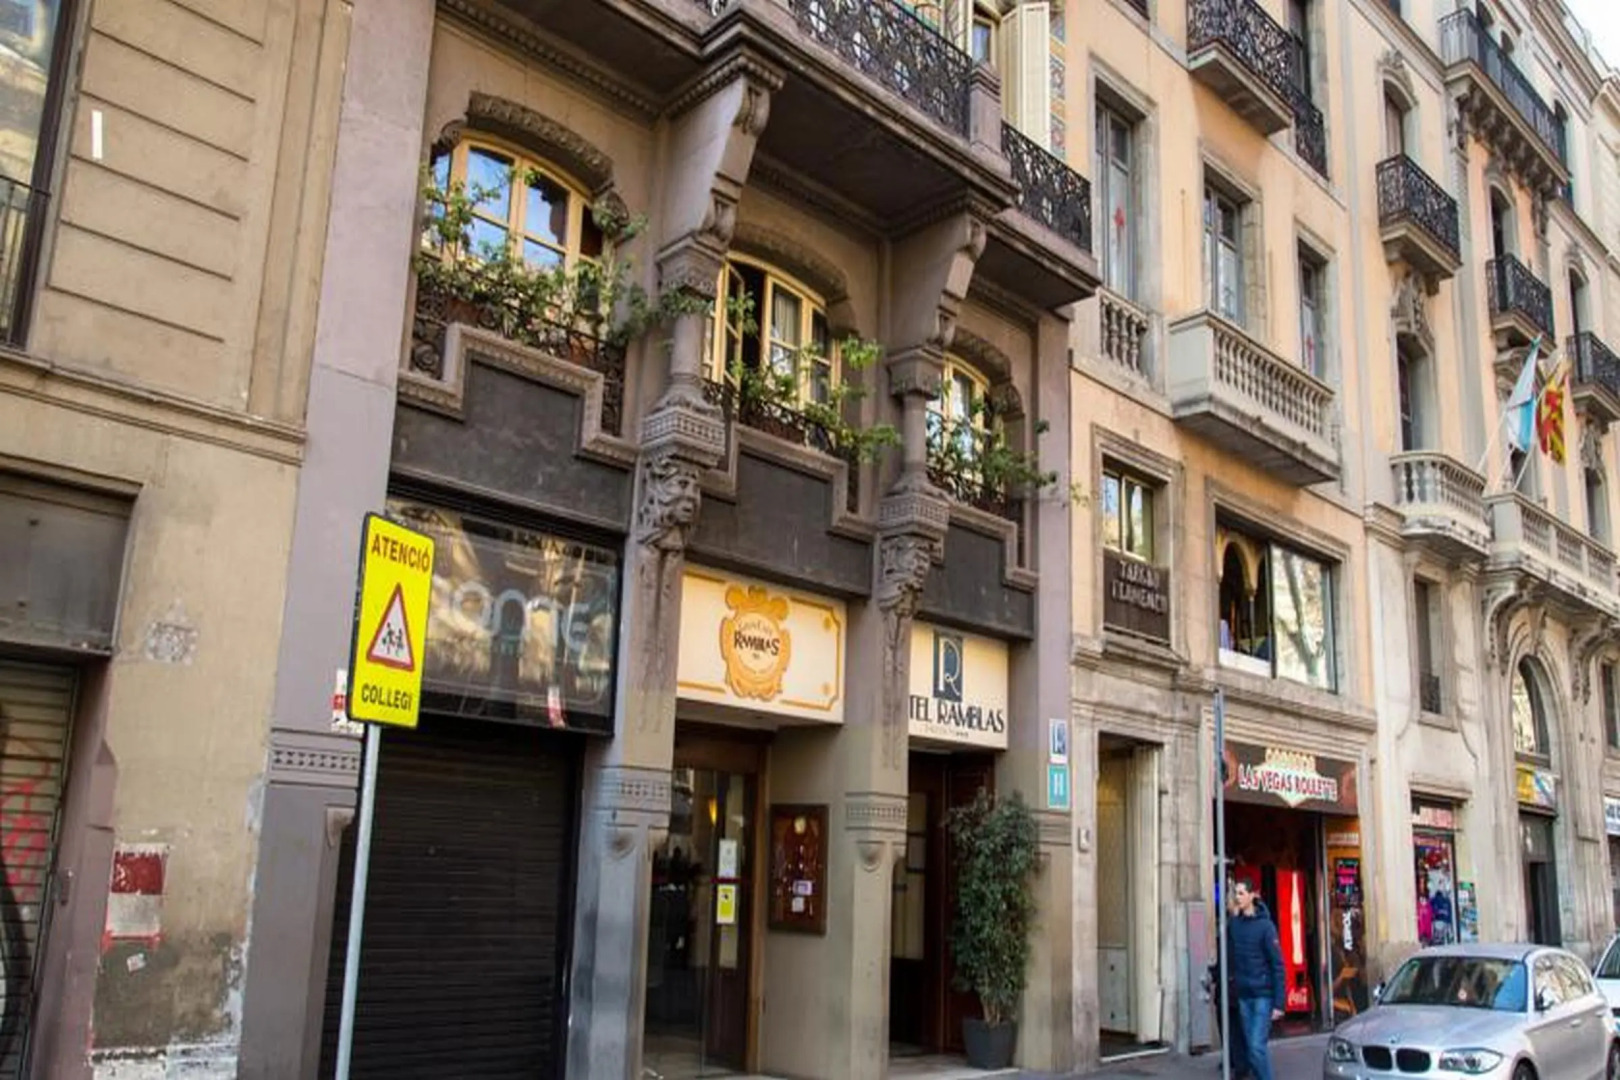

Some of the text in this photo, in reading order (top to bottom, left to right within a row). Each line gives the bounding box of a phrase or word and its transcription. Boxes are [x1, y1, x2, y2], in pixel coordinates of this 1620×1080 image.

[372, 533, 430, 573] ATENCIÓ
[361, 683, 412, 712] COLLEGI
[937, 699, 1005, 734] RAMBLAS
[1238, 762, 1338, 802] LAS VEGAS ROULETTE
